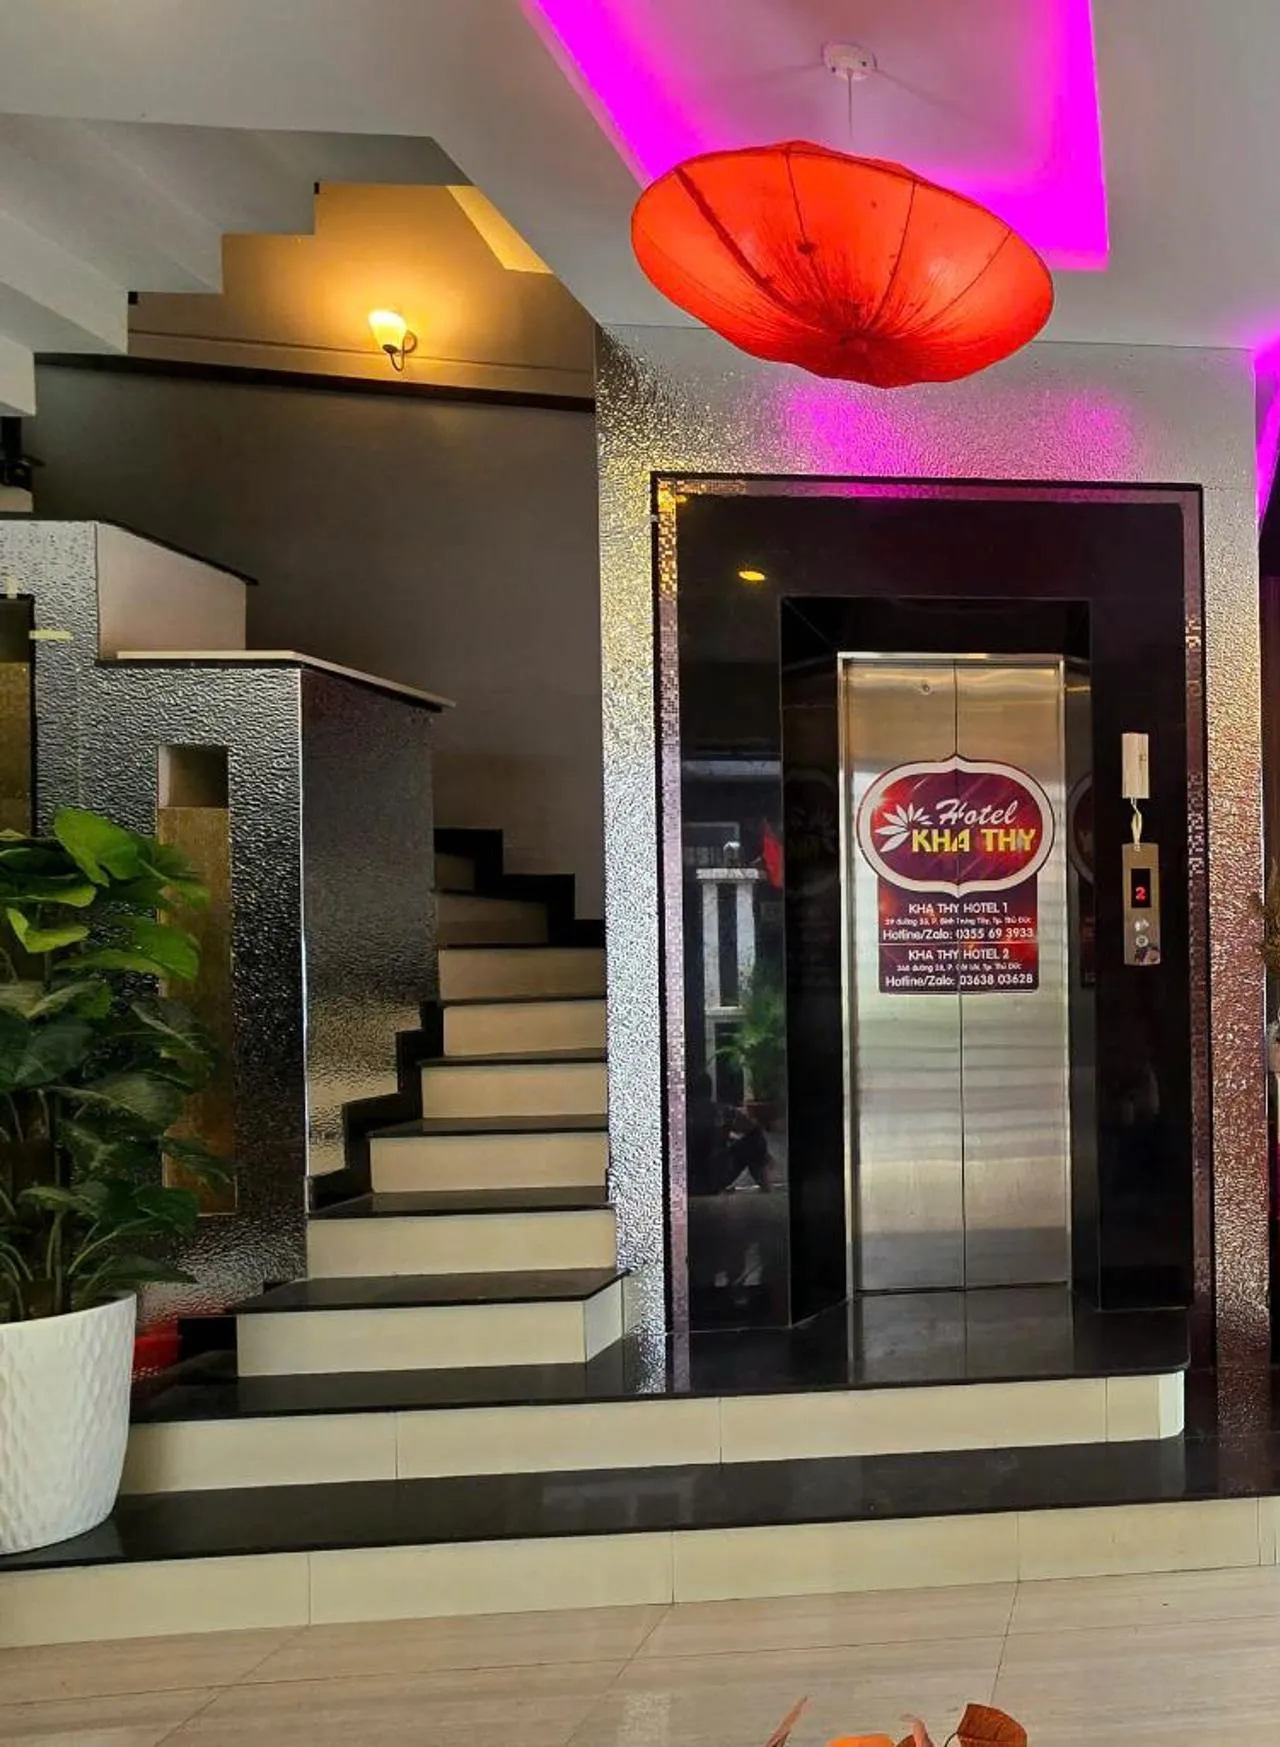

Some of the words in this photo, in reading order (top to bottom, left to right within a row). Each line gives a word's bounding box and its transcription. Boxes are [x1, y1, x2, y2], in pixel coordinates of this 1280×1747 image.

[936, 798, 1018, 825] Hotel
[912, 828, 970, 852] KHA
[980, 828, 1036, 852] THY
[1135, 886, 1147, 900] 2
[909, 903, 934, 913] KHA
[937, 903, 960, 913] THY
[963, 902, 1000, 913] HOTEL
[1003, 902, 1008, 912] 1
[988, 928, 1002, 938] 69
[1006, 927, 1034, 938] 3933
[908, 949, 934, 960] KHA
[937, 949, 960, 960] THY
[963, 949, 1000, 959] HOTEL
[1002, 949, 1010, 959] 2
[960, 974, 994, 985] 03638
[997, 973, 1033, 985] 03628
